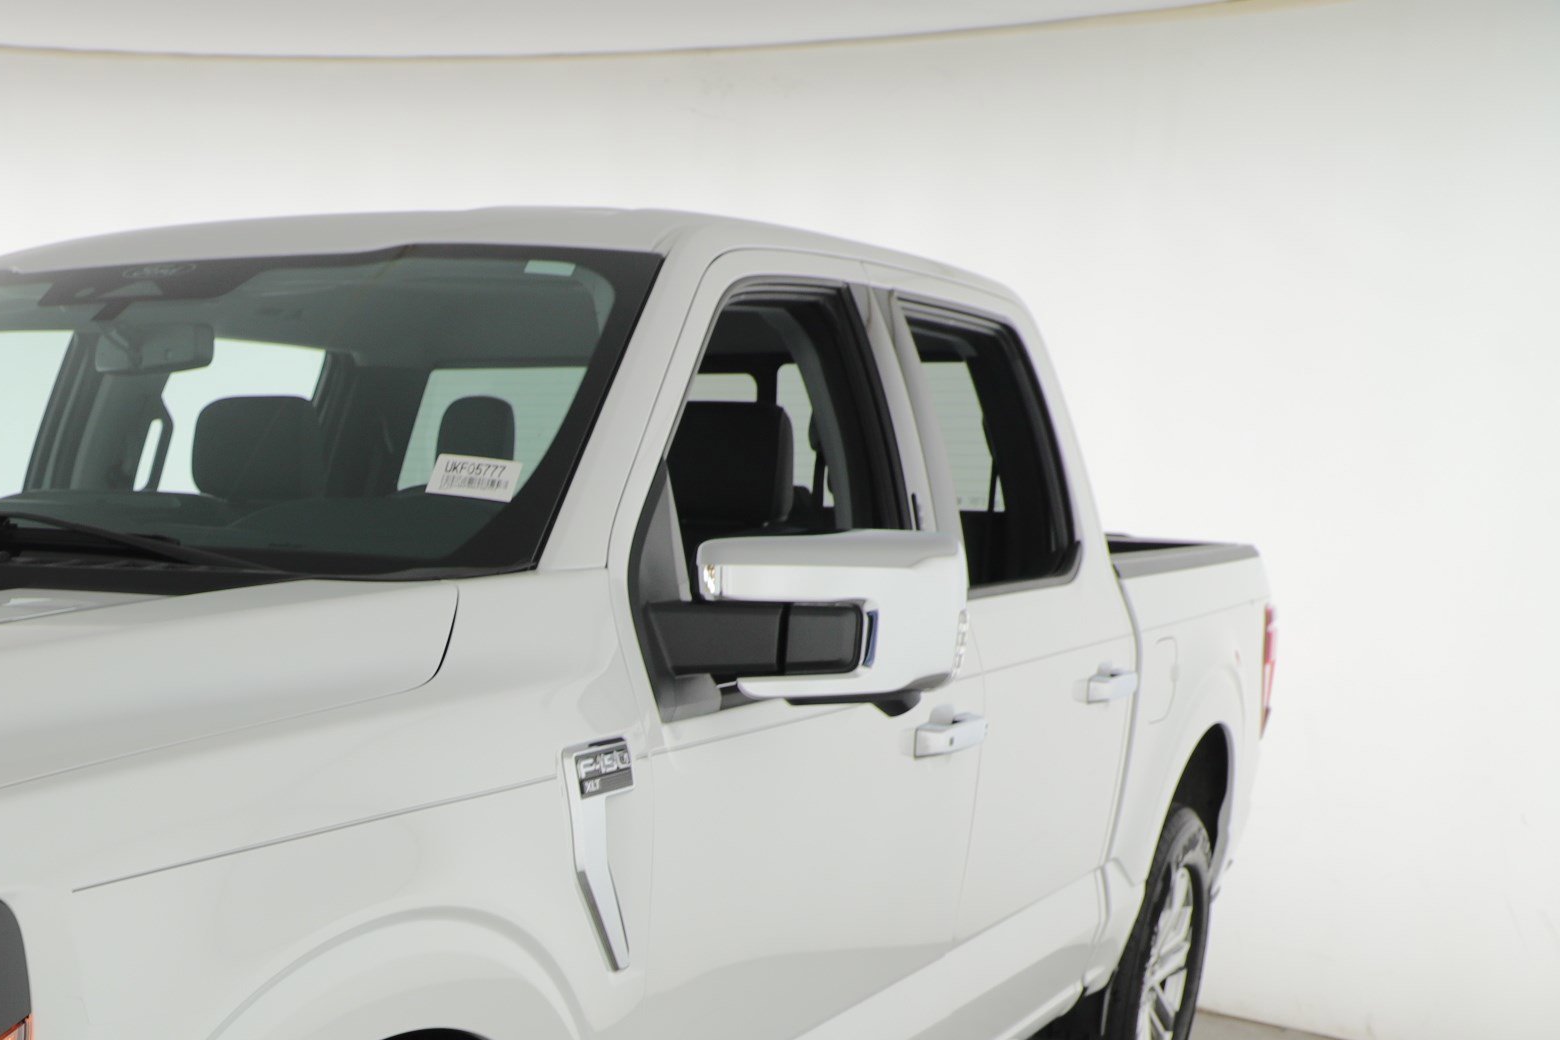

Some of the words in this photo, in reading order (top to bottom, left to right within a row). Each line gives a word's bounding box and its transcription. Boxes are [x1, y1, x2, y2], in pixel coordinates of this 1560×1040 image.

[444, 460, 507, 477] UKF05777
[578, 749, 631, 779] F-150
[583, 779, 600, 793] XLT
